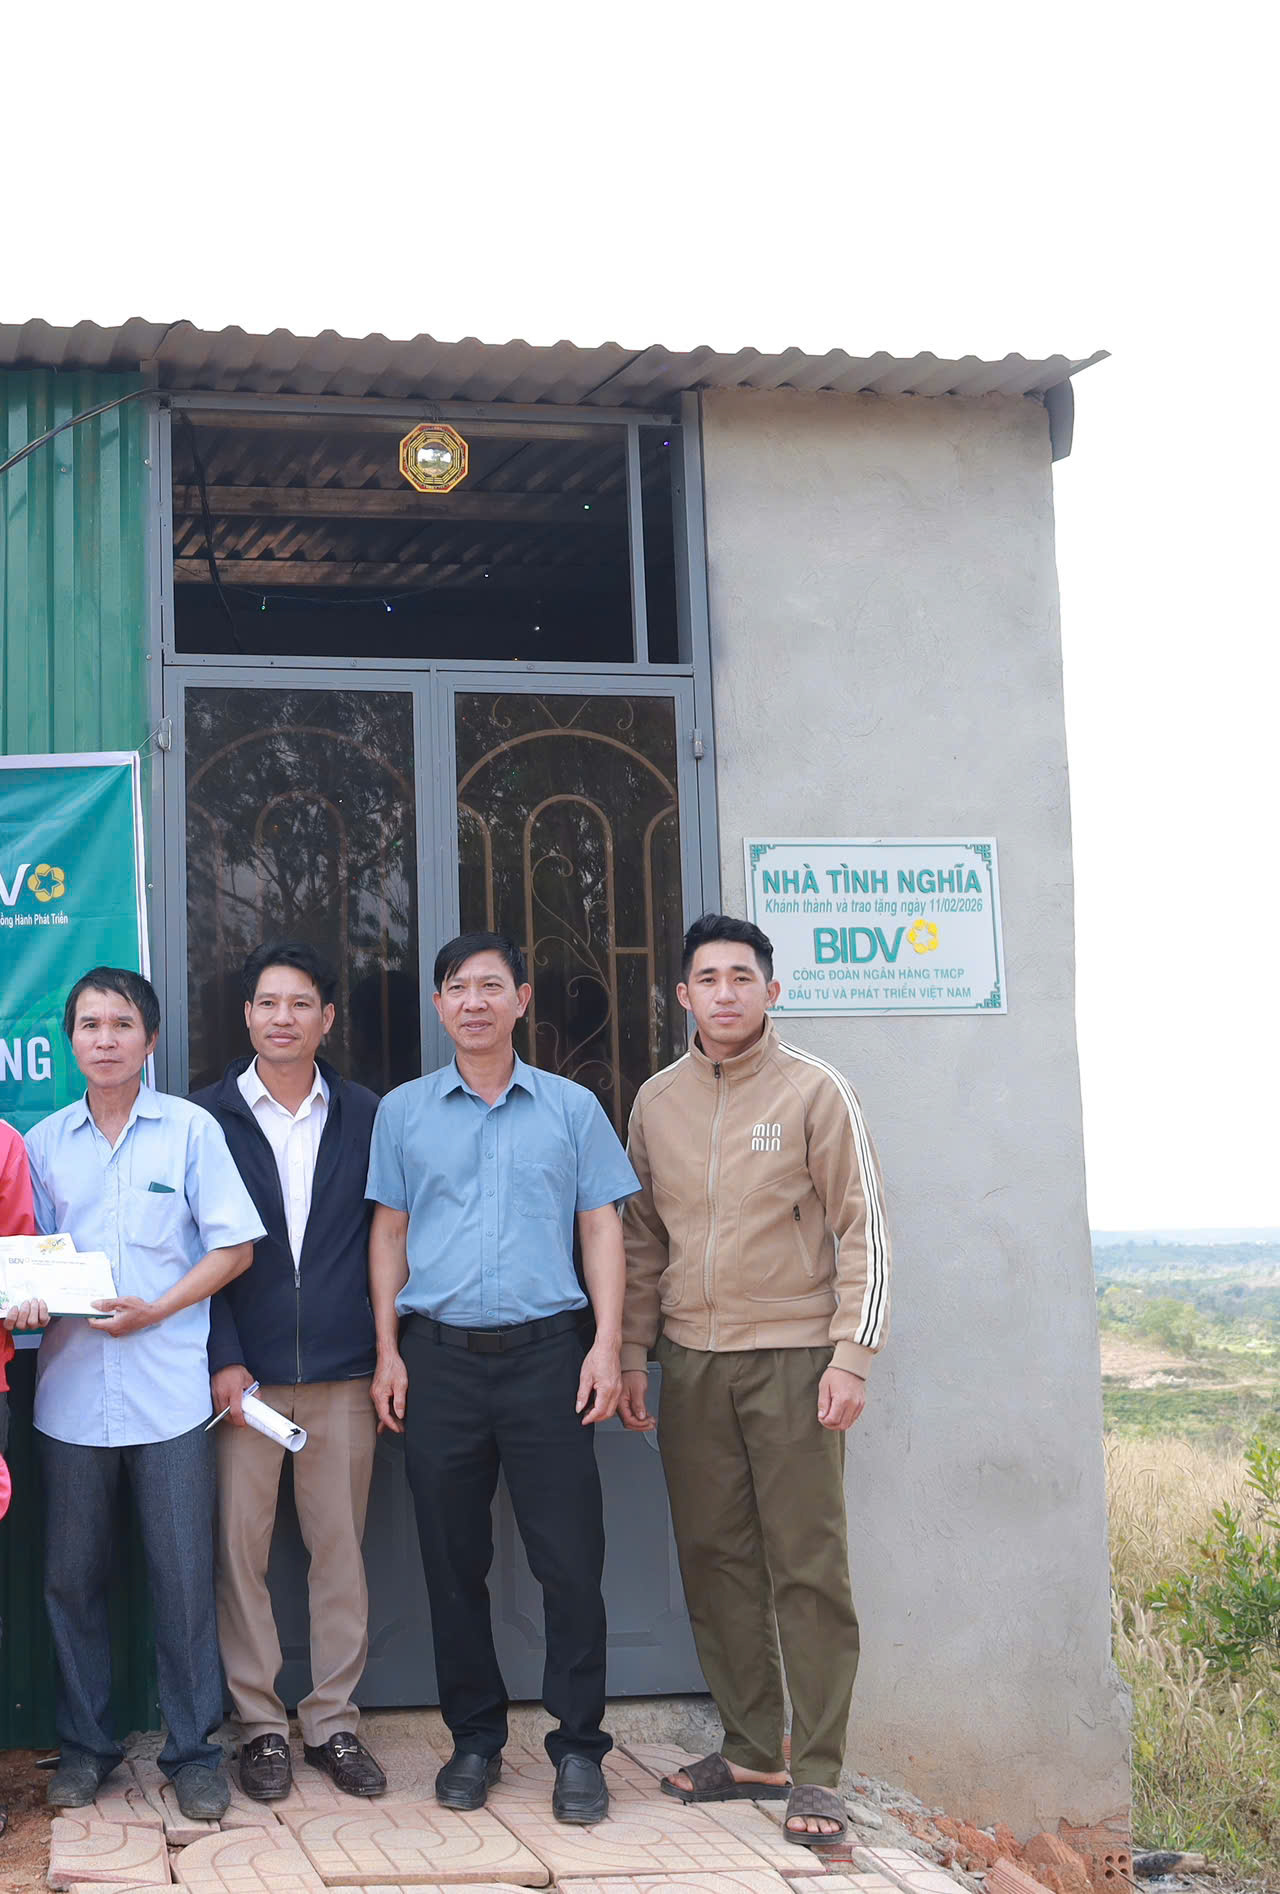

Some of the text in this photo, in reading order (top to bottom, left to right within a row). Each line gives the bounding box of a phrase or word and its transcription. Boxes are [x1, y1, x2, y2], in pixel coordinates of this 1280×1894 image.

[762, 863, 982, 894] NHÀ TÌNH NGHĨA
[765, 897, 983, 916] Khánh thành và trao tặng ngày 11/02/2026
[15, 914, 33, 926] Hành
[34, 912, 50, 925] Phát
[51, 910, 69, 924] Triển
[813, 926, 906, 964] BIDV
[792, 966, 965, 981] CÔNG ĐOÀN NGÂN HÀNG TMCP
[788, 985, 811, 1000] ĐẦU
[832, 986, 847, 999] VÀ
[850, 985, 879, 999] PHÁT
[883, 983, 916, 998] TRIỂN
[920, 985, 944, 1000] VIỆT
[946, 987, 971, 998] NAM
